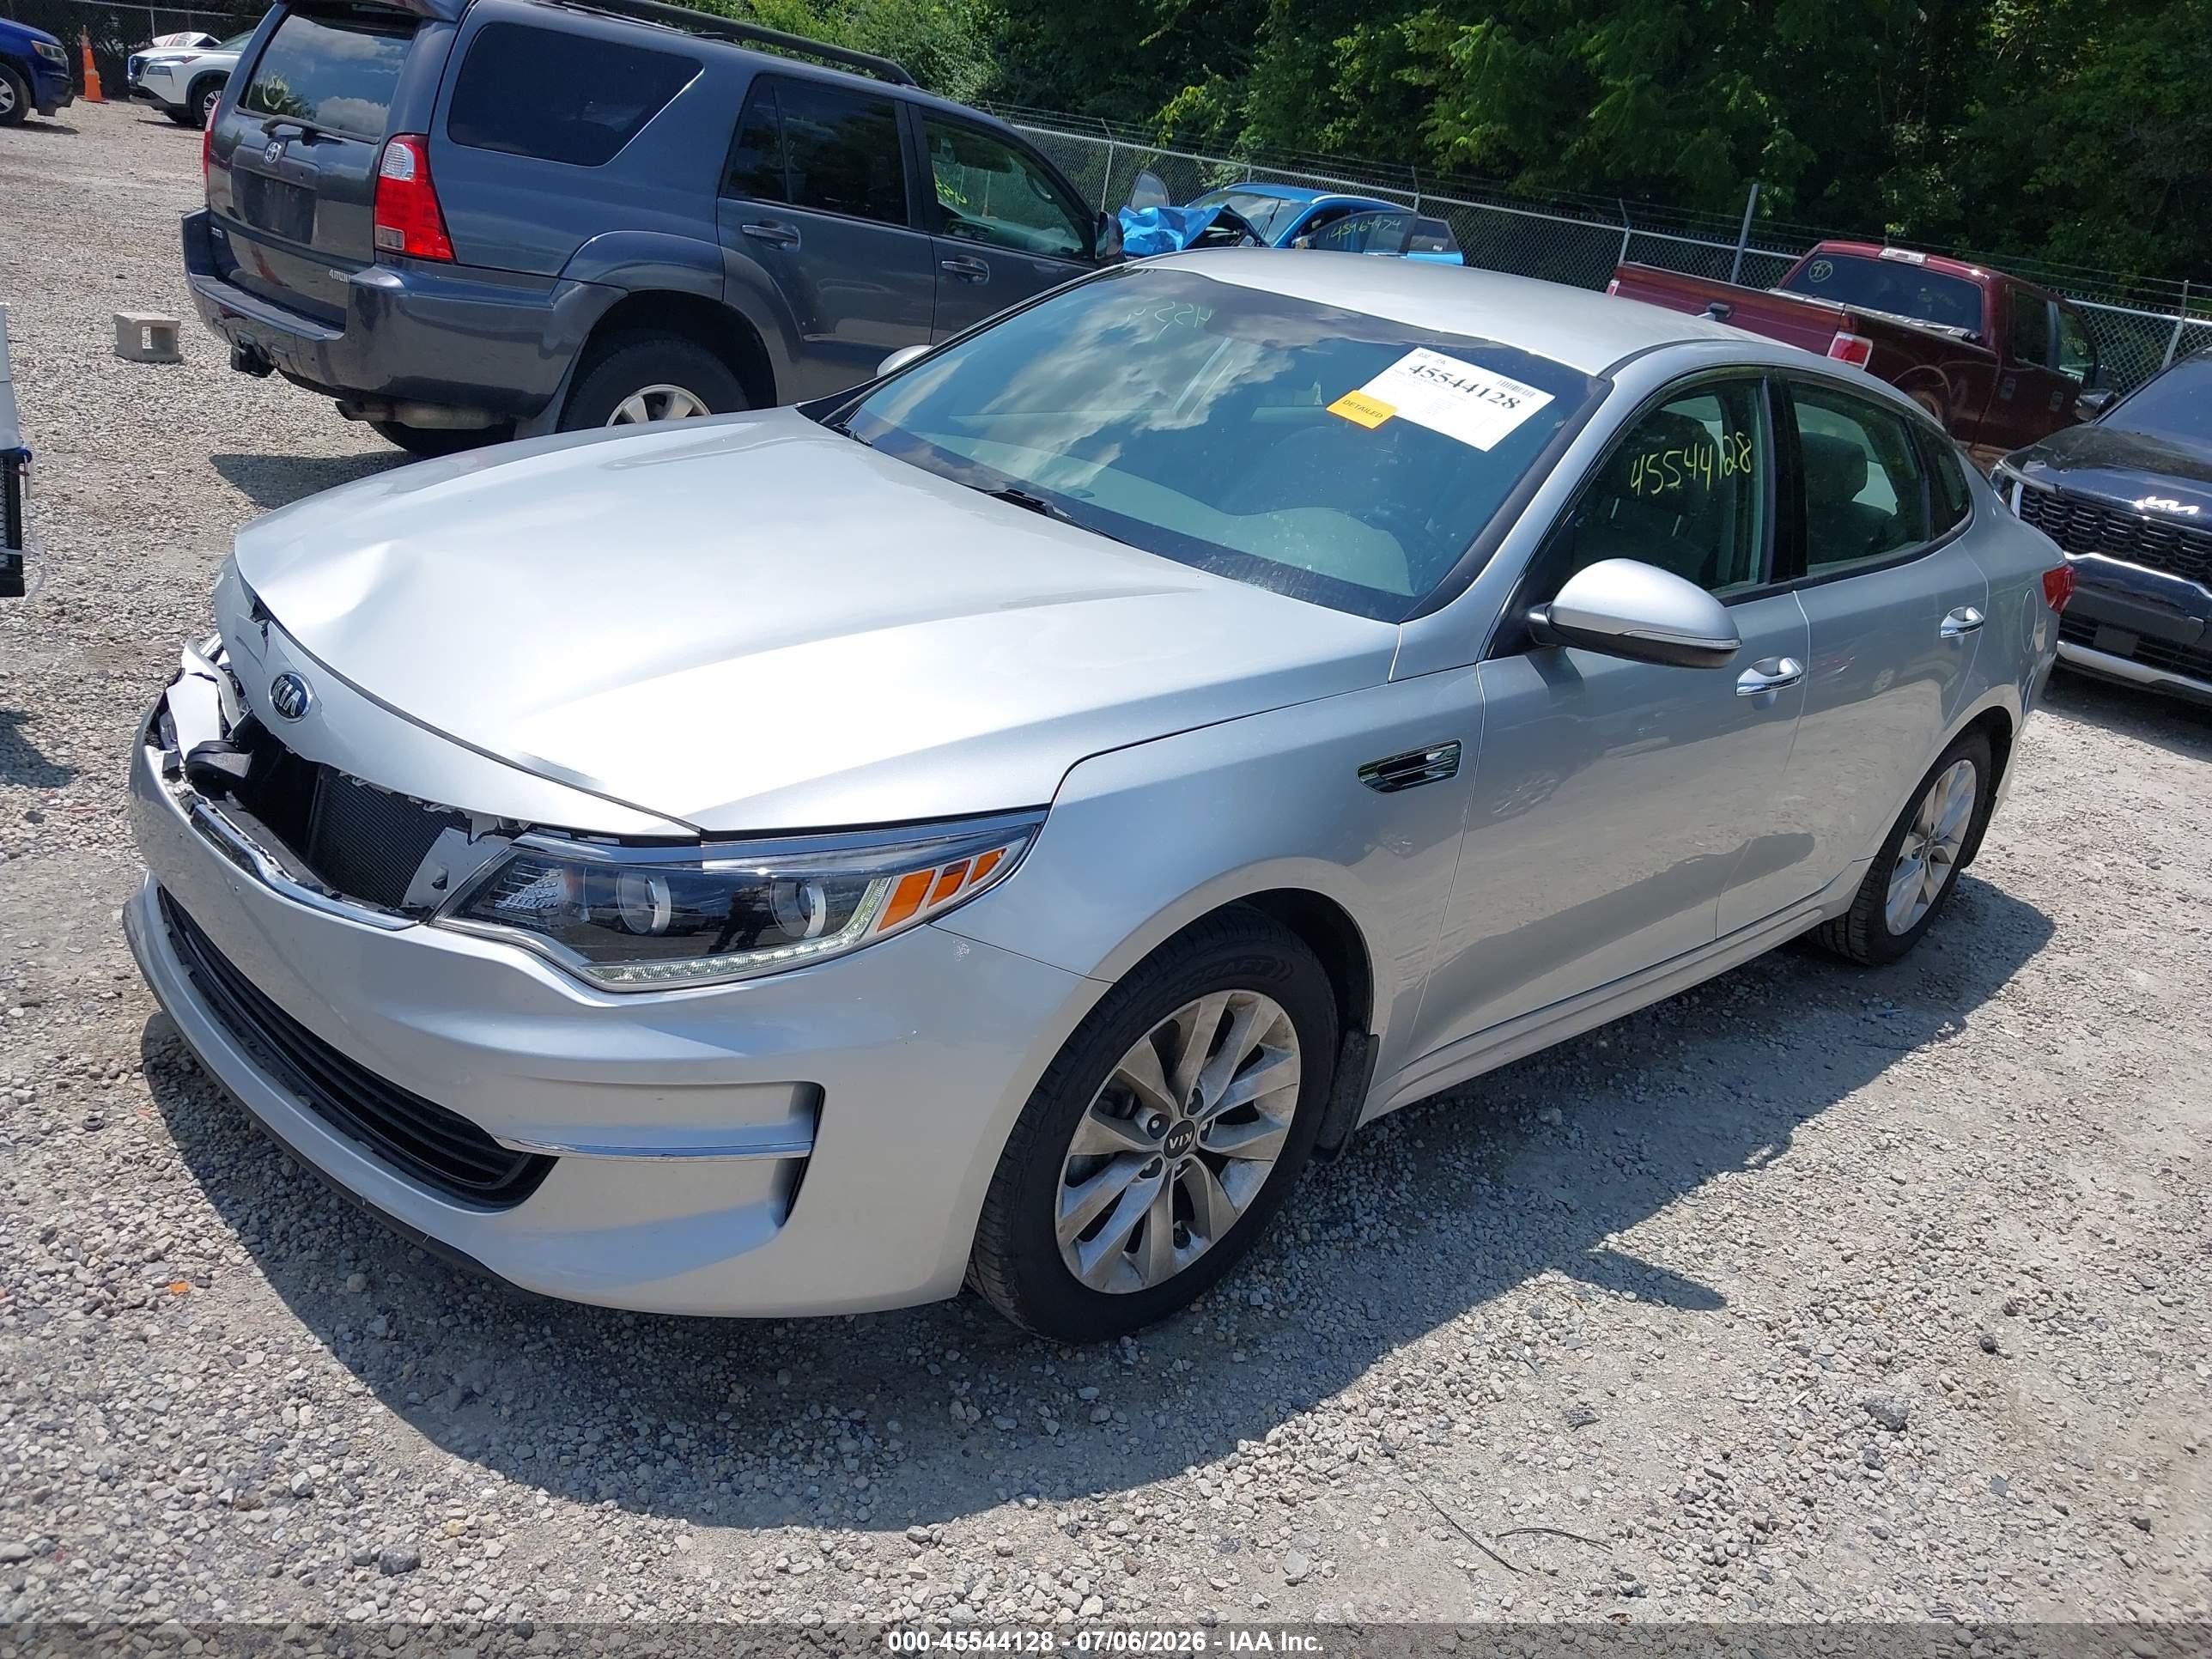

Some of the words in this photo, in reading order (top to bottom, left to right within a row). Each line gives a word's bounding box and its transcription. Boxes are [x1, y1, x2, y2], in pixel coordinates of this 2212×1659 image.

[1408, 363, 1521, 410] 45544128
[1342, 398, 1383, 420] DETAILED
[1630, 431, 1752, 496] 45544128
[272, 676, 302, 716] KIA
[1169, 1130, 1193, 1150] KIA
